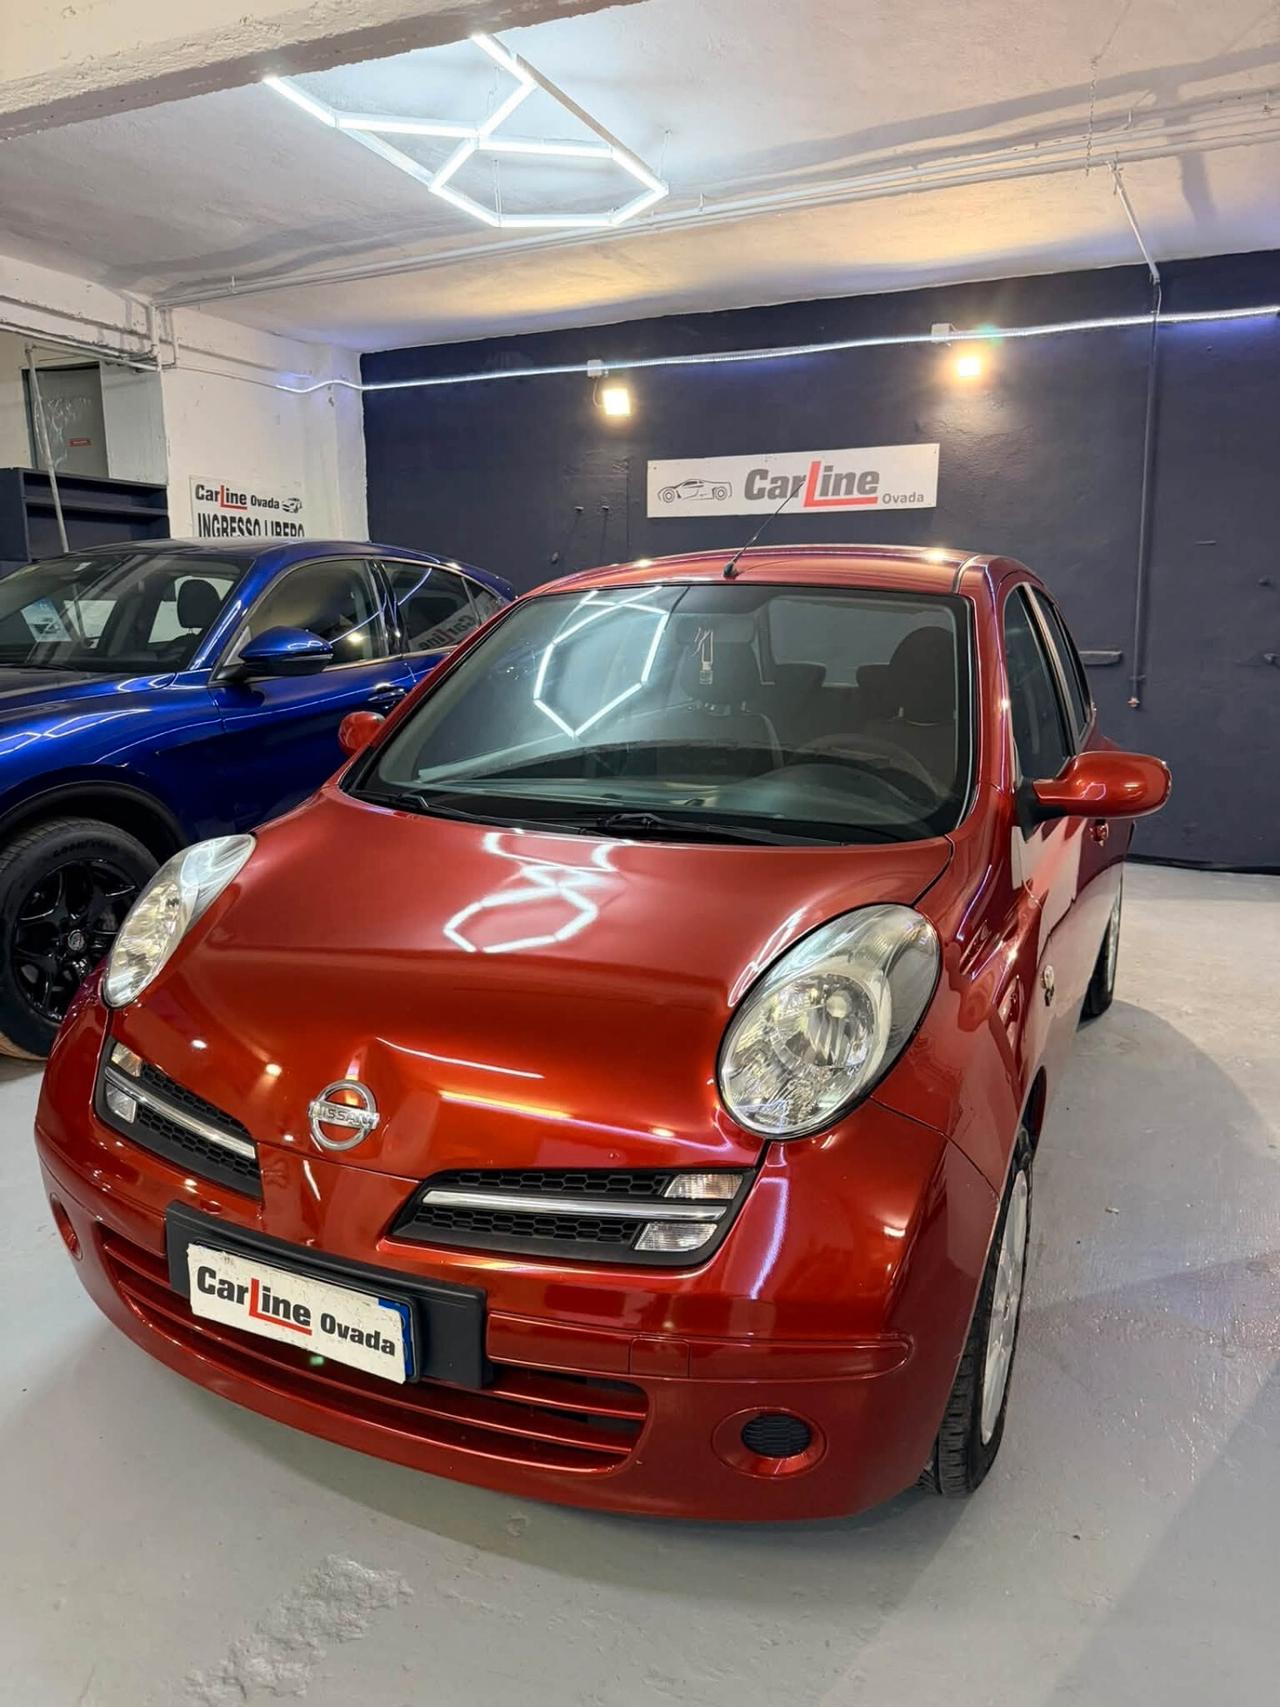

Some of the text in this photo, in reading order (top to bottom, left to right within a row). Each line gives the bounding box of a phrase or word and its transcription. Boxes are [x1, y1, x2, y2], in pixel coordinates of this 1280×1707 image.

[195, 483, 280, 510] CarLine Ovada
[744, 461, 925, 507] CarLine Ovada
[198, 512, 261, 538] INGRESSO
[312, 1102, 375, 1127] NISSAN
[197, 1265, 396, 1357] CarLine Ovada
